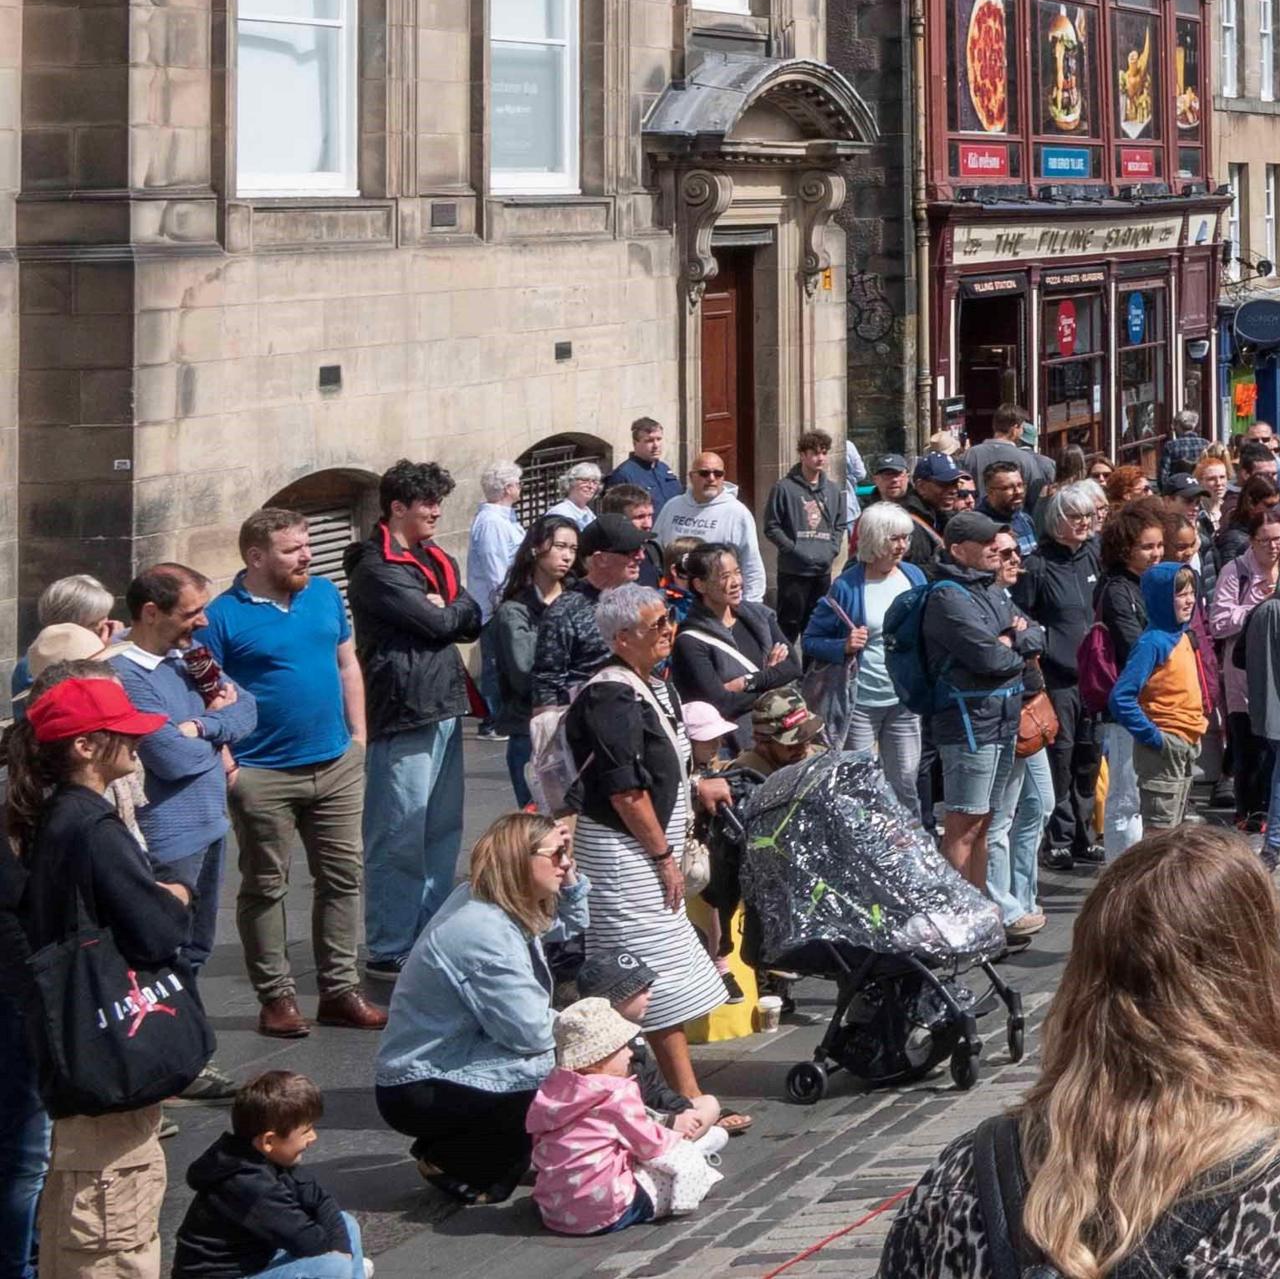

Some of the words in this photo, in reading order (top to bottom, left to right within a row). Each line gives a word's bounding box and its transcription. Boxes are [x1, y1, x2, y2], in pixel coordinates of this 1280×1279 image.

[995, 232, 1025, 257] THE
[1037, 228, 1094, 255] FILLING
[1103, 226, 1154, 251] STATION
[974, 280, 994, 292] FILLING
[672, 515, 718, 529] RECYCLE
